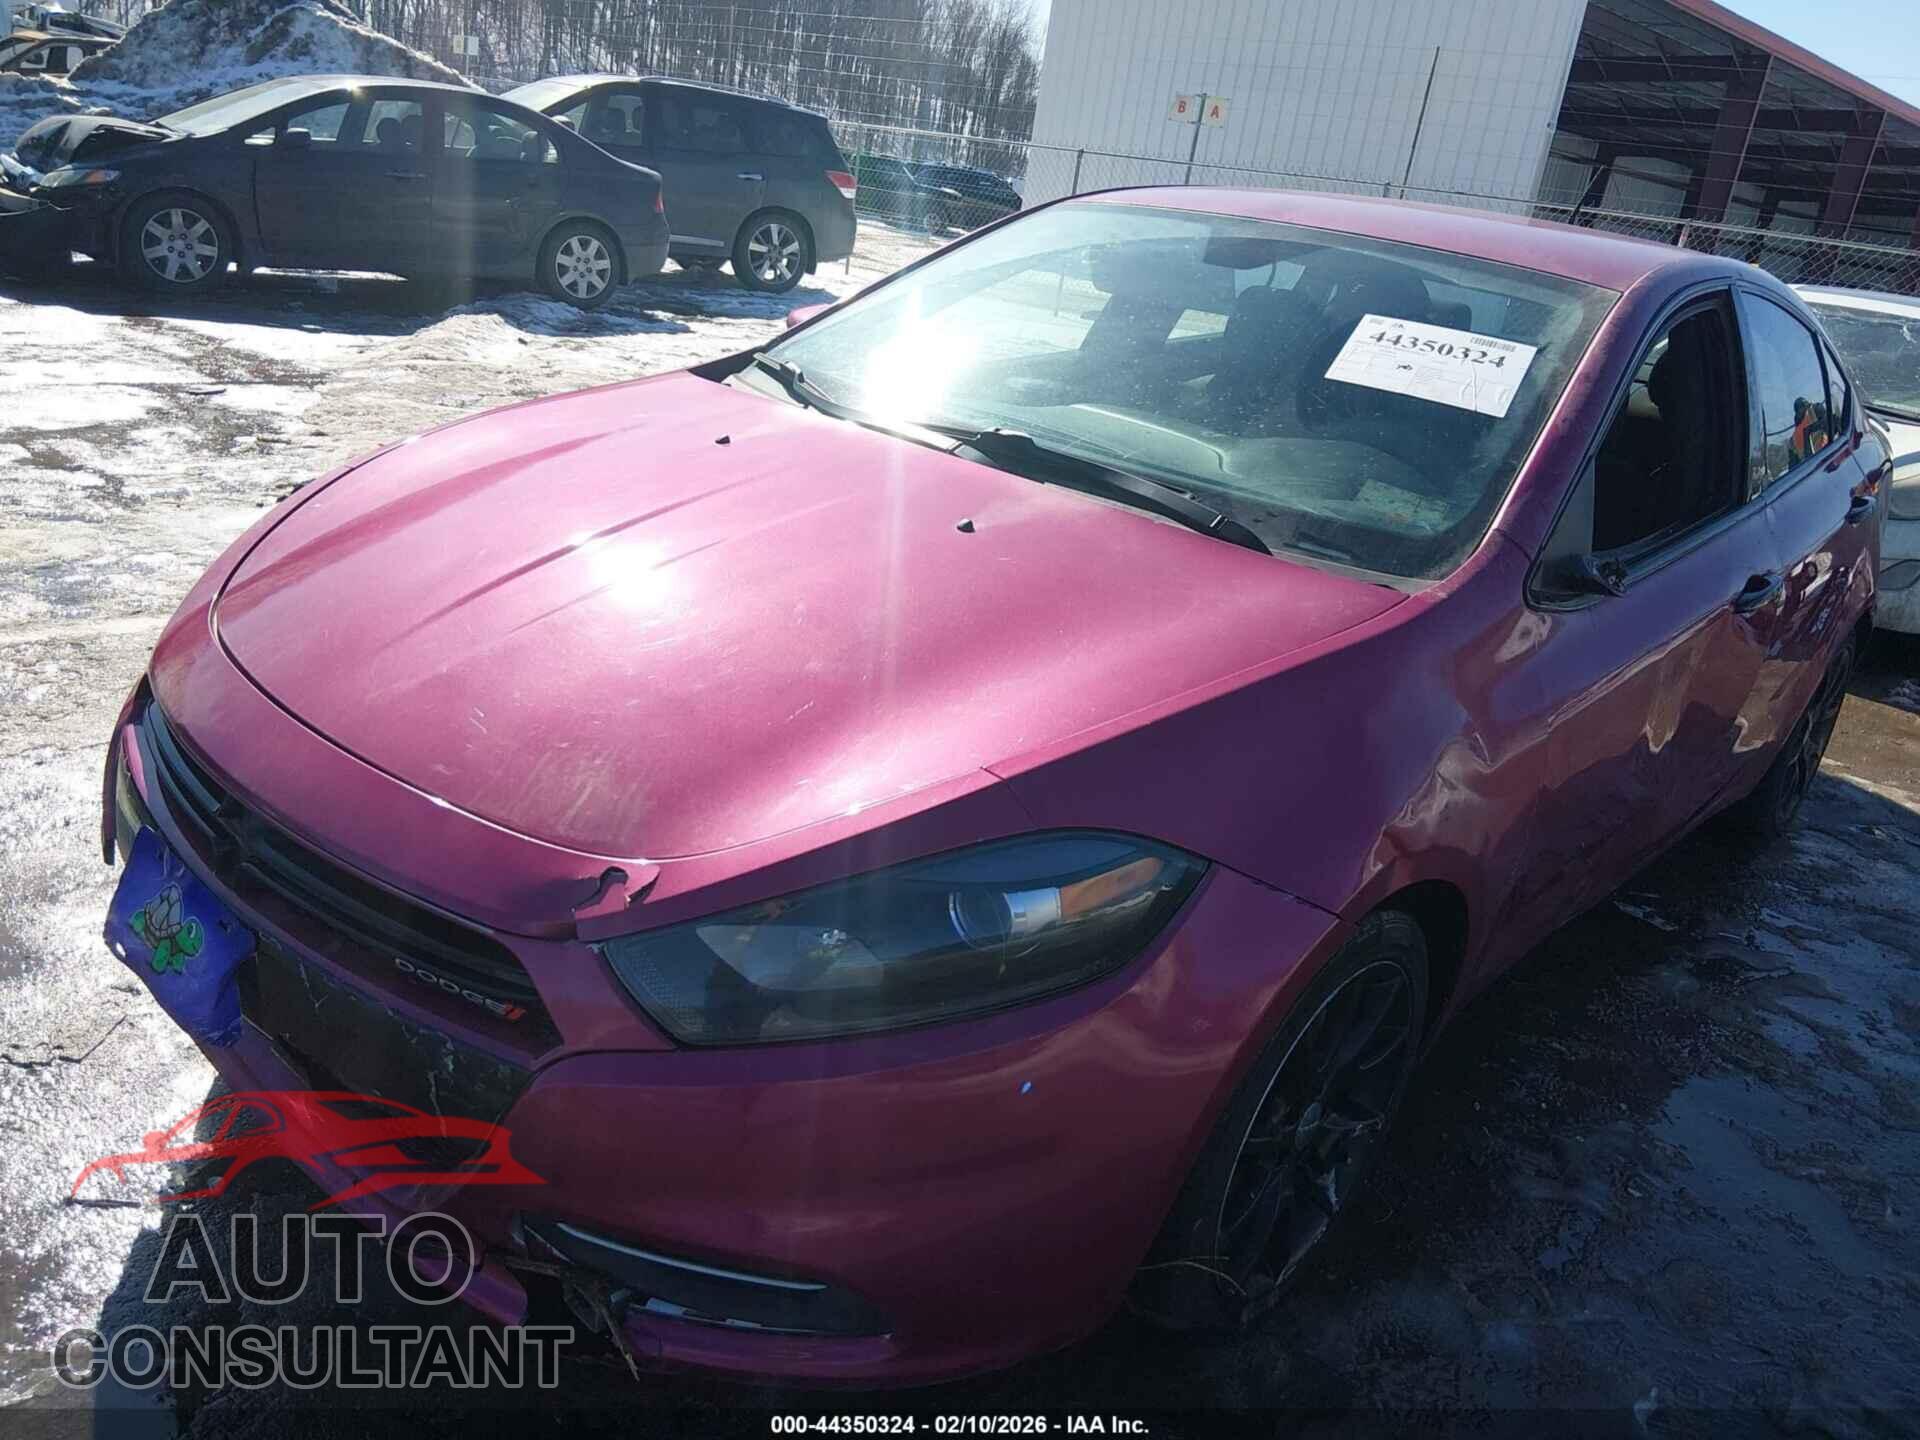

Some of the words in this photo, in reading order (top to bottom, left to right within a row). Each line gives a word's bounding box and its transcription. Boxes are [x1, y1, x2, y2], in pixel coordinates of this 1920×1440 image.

[1177, 100, 1186, 113] B
[1210, 105, 1220, 119] A
[1369, 331, 1507, 368] 44350324
[394, 957, 507, 1016] DODGE
